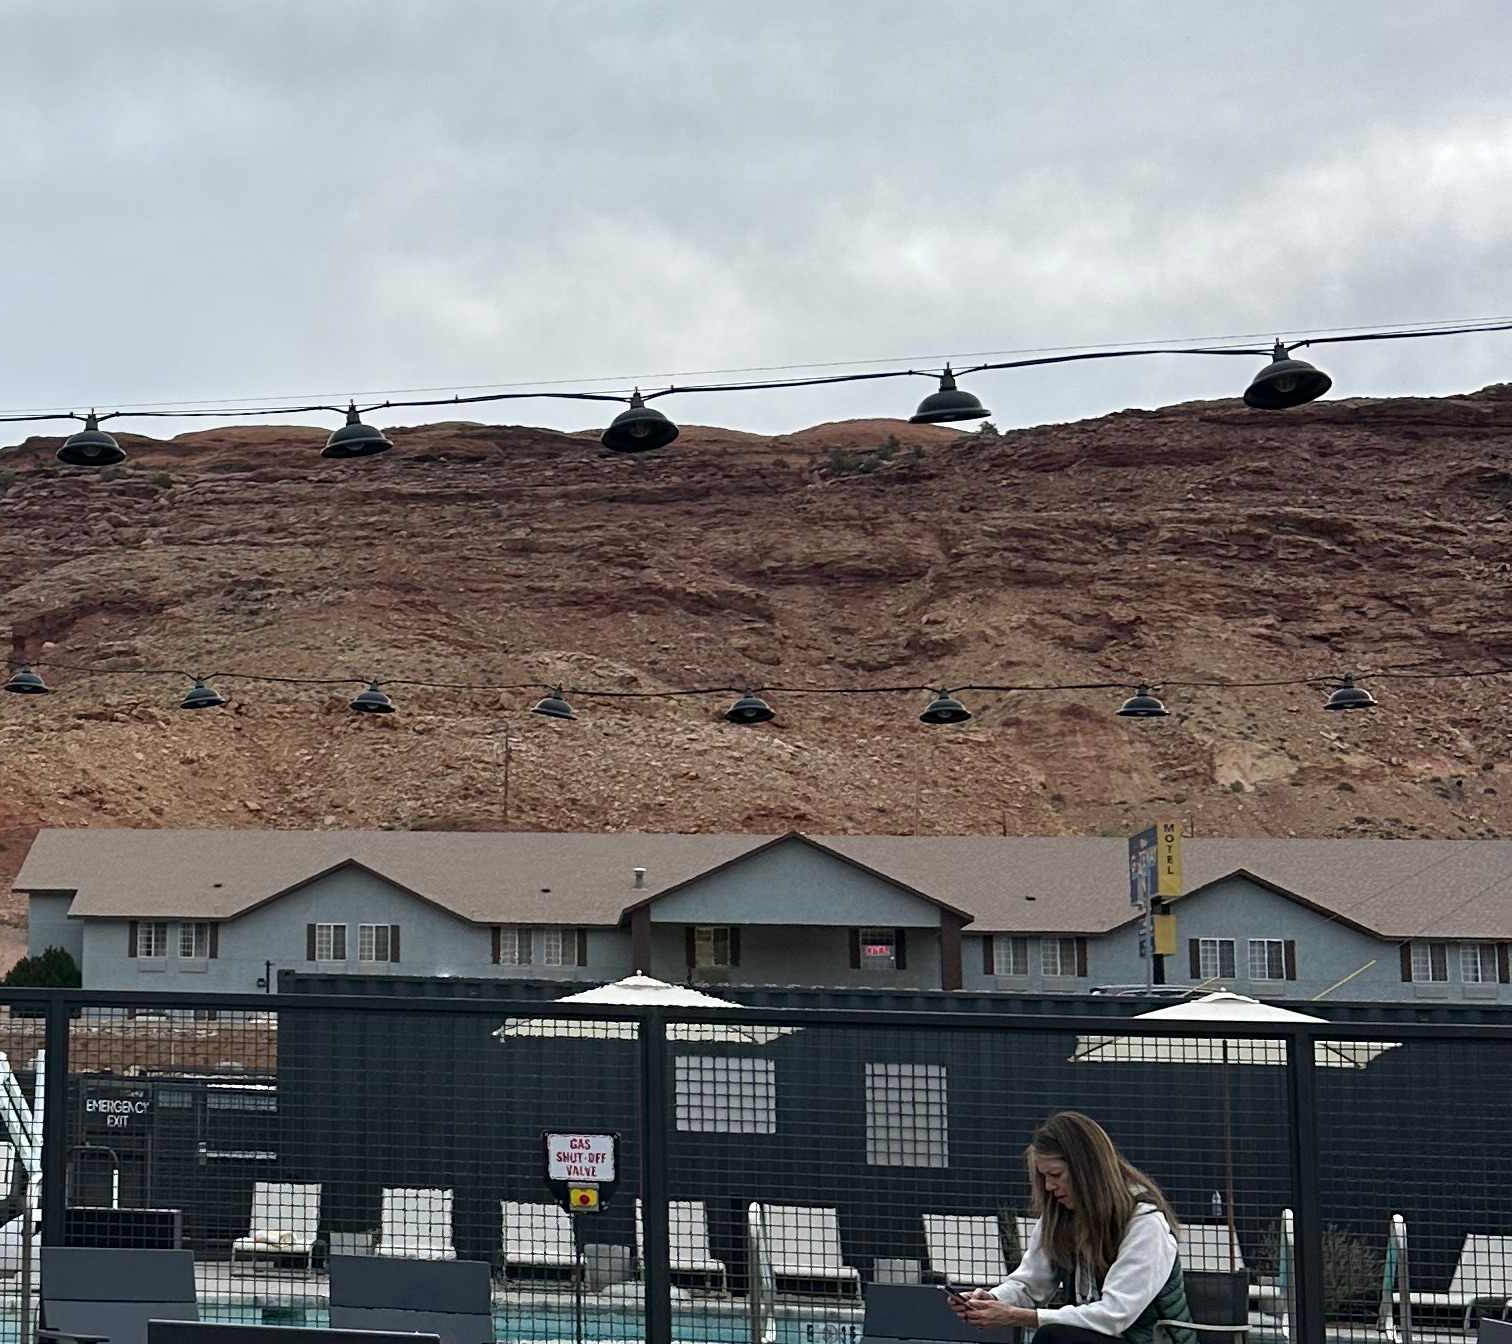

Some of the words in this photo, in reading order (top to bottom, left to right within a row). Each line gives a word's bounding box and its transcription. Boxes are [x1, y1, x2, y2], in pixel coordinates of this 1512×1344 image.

[1164, 823, 1175, 875] MOTEL
[86, 1099, 149, 1113] EMERGENCY
[107, 1115, 128, 1128] EXIT
[570, 1138, 591, 1150] GAS
[567, 1166, 597, 1177] VALVE
